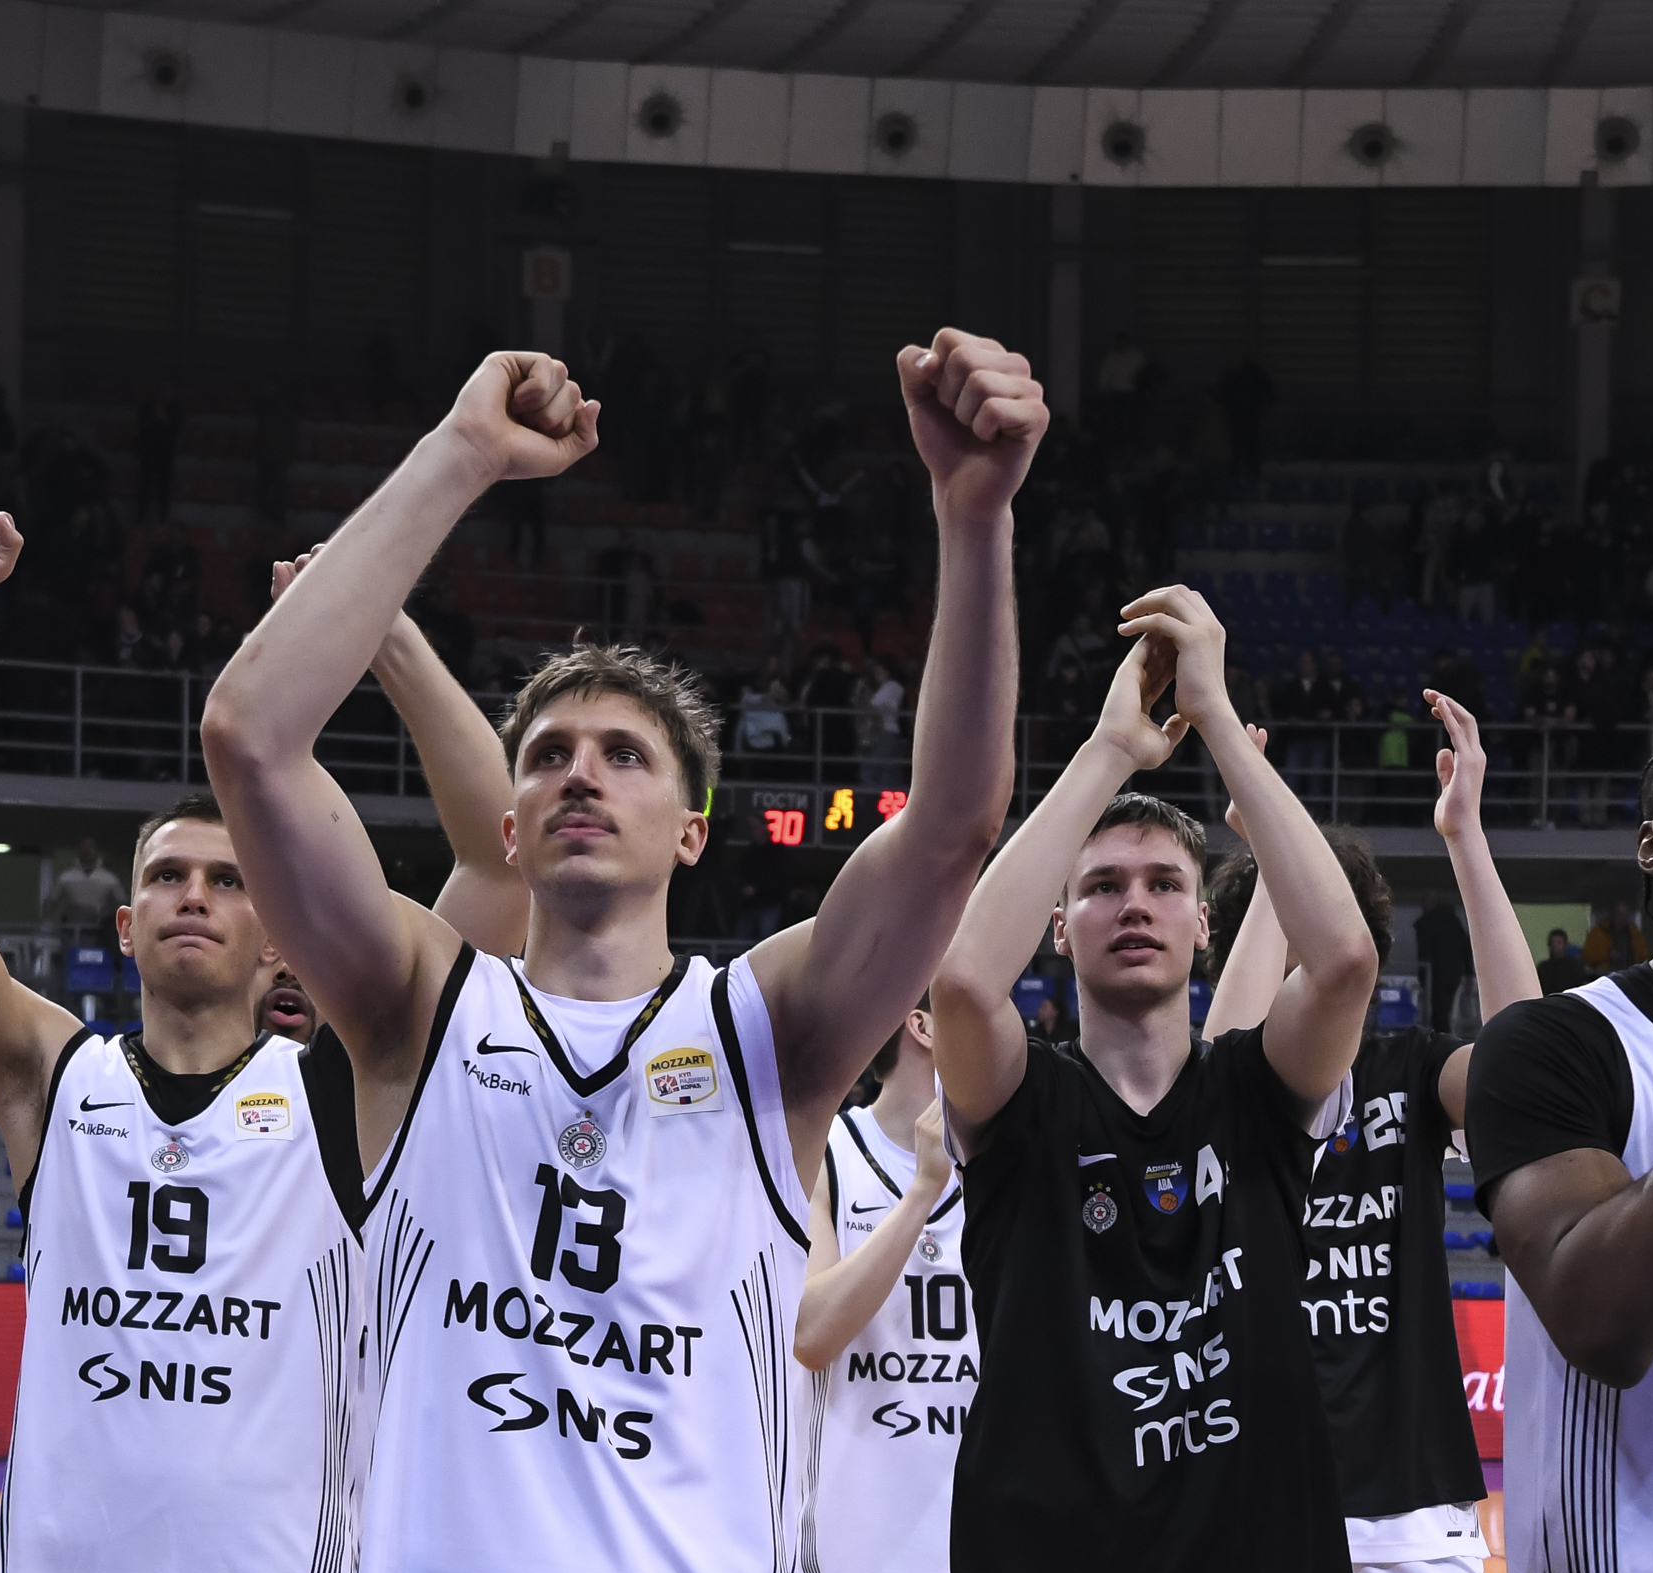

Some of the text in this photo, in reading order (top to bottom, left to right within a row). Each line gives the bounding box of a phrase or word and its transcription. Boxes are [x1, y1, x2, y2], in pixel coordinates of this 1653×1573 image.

[467, 1063, 533, 1097] AikBank
[651, 1054, 706, 1072] MOZZART
[240, 1098, 285, 1107] MOZZART
[75, 1121, 130, 1139] AikBank
[1146, 1161, 1182, 1174] ADMIRAL
[1158, 1178, 1174, 1192] ABA
[1195, 1143, 1230, 1206] 4
[127, 1181, 210, 1274] 19
[531, 1163, 628, 1295] 13
[1329, 1243, 1393, 1280] NIS
[61, 1286, 282, 1341] MOZZART
[903, 1273, 968, 1341] 10
[443, 1278, 704, 1378] MOZZART
[139, 1360, 233, 1405] NIS
[847, 1351, 980, 1384] MOZZA
[927, 1405, 968, 1435] NI
[1133, 1398, 1241, 1467] mts
